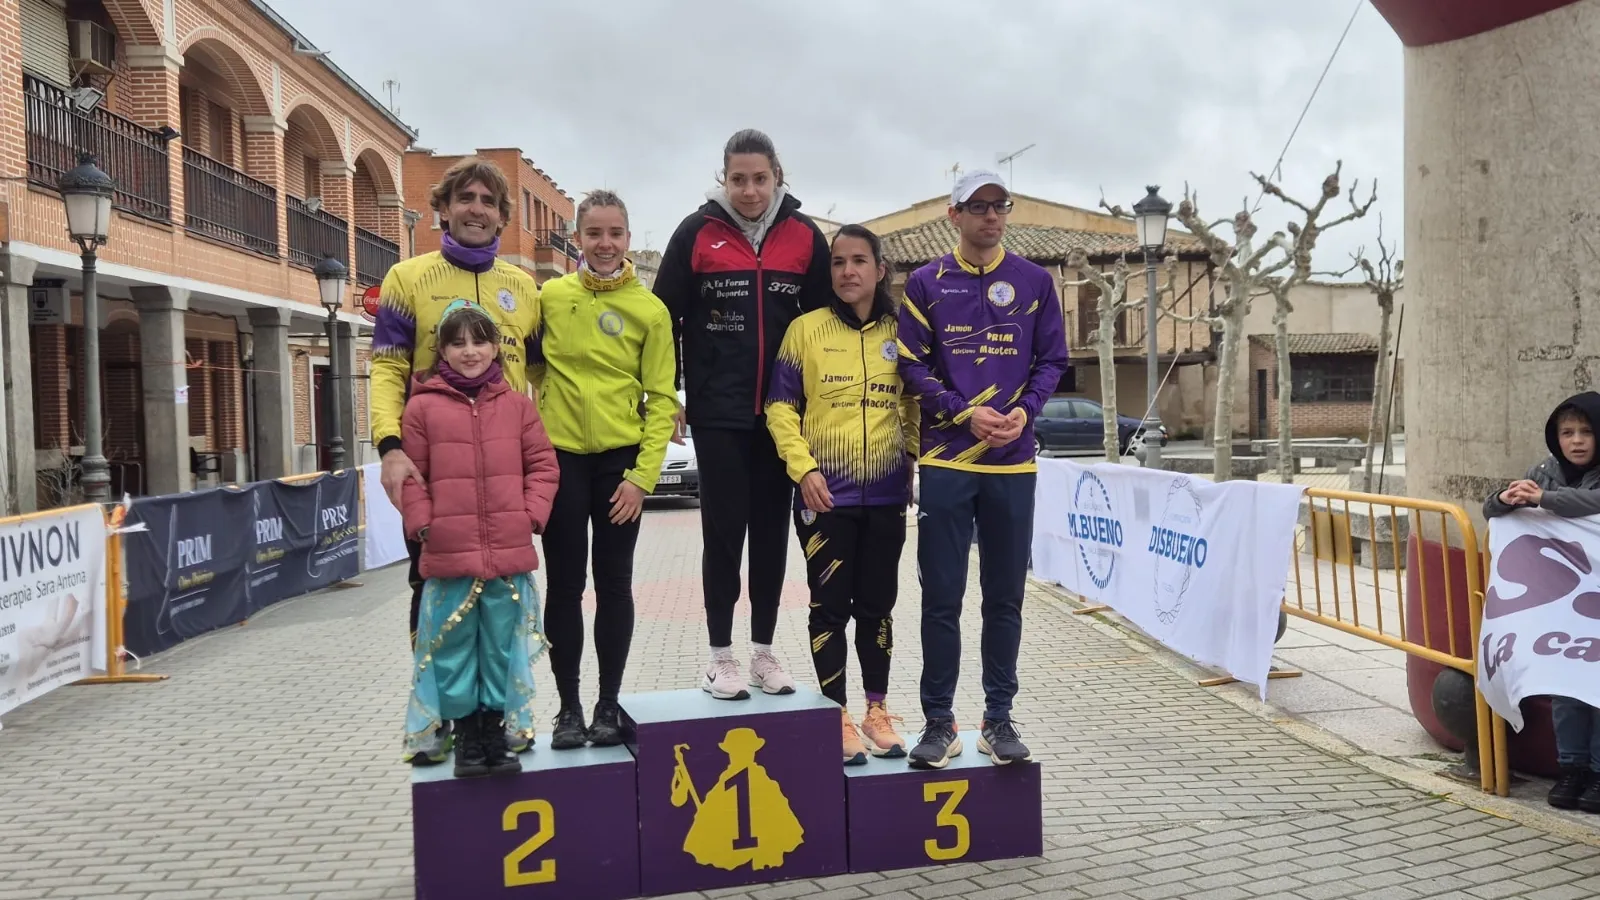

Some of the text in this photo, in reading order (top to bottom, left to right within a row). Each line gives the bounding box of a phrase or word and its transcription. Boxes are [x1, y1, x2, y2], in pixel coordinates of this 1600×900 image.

[716, 290, 749, 298] Deportes
[725, 279, 749, 287] Forma
[706, 322, 745, 333] aparicio
[987, 332, 1014, 343] PRIM
[980, 345, 1018, 356] Macotera
[870, 383, 897, 395] PRIM
[256, 517, 283, 544] PRIM
[1068, 512, 1123, 548] M.BUENO
[0, 520, 80, 582] IVNON
[177, 534, 213, 569] PRIM
[1148, 525, 1208, 569] DISBUENO
[36, 580, 55, 599] Sara
[57, 571, 86, 590] Antona
[1482, 632, 1517, 681] La
[725, 768, 758, 851] 1
[923, 780, 970, 861] 3
[502, 799, 556, 888] 2
